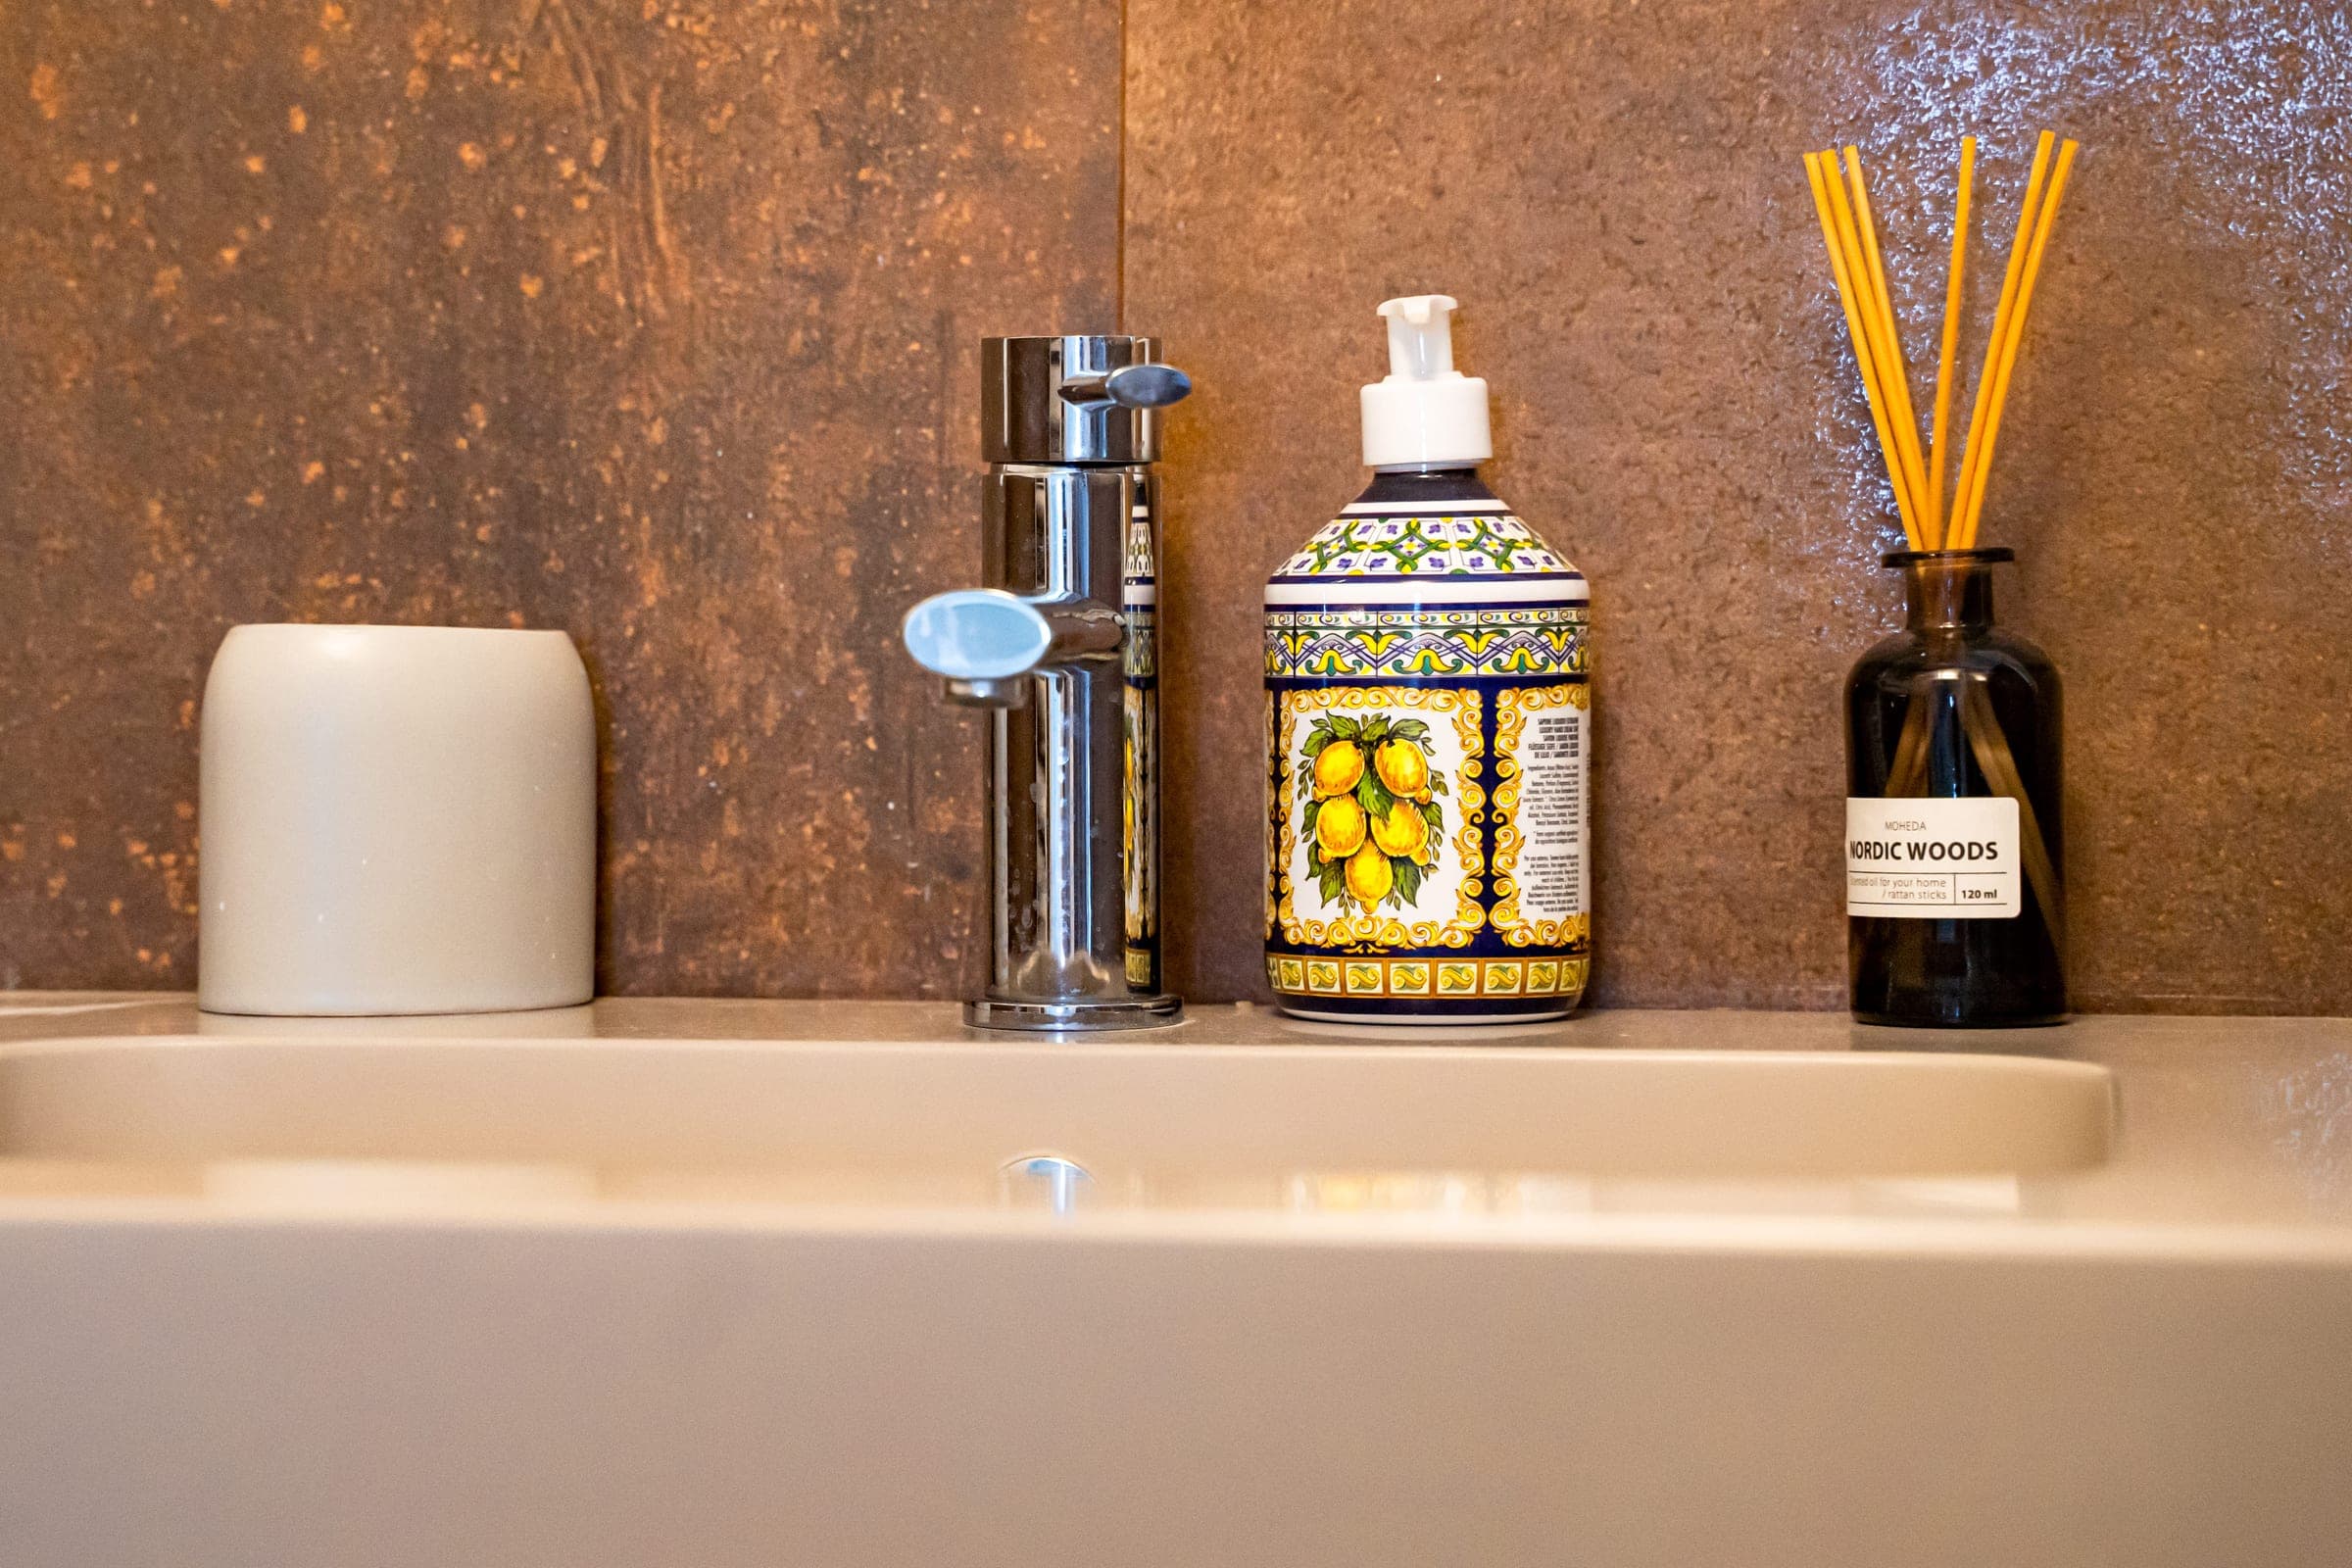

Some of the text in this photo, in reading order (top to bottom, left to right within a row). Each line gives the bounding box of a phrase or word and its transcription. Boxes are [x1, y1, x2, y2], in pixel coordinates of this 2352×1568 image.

[1885, 821, 1927, 831] MOHEDA
[1849, 841, 1998, 860] NORDIC WOODS
[1880, 877, 1890, 886] for
[1892, 878, 1913, 888] your
[1916, 878, 1946, 887] home
[1888, 890, 1914, 899] rattan
[1918, 890, 1946, 899] sticks
[1962, 889, 1997, 899] 120 ml
